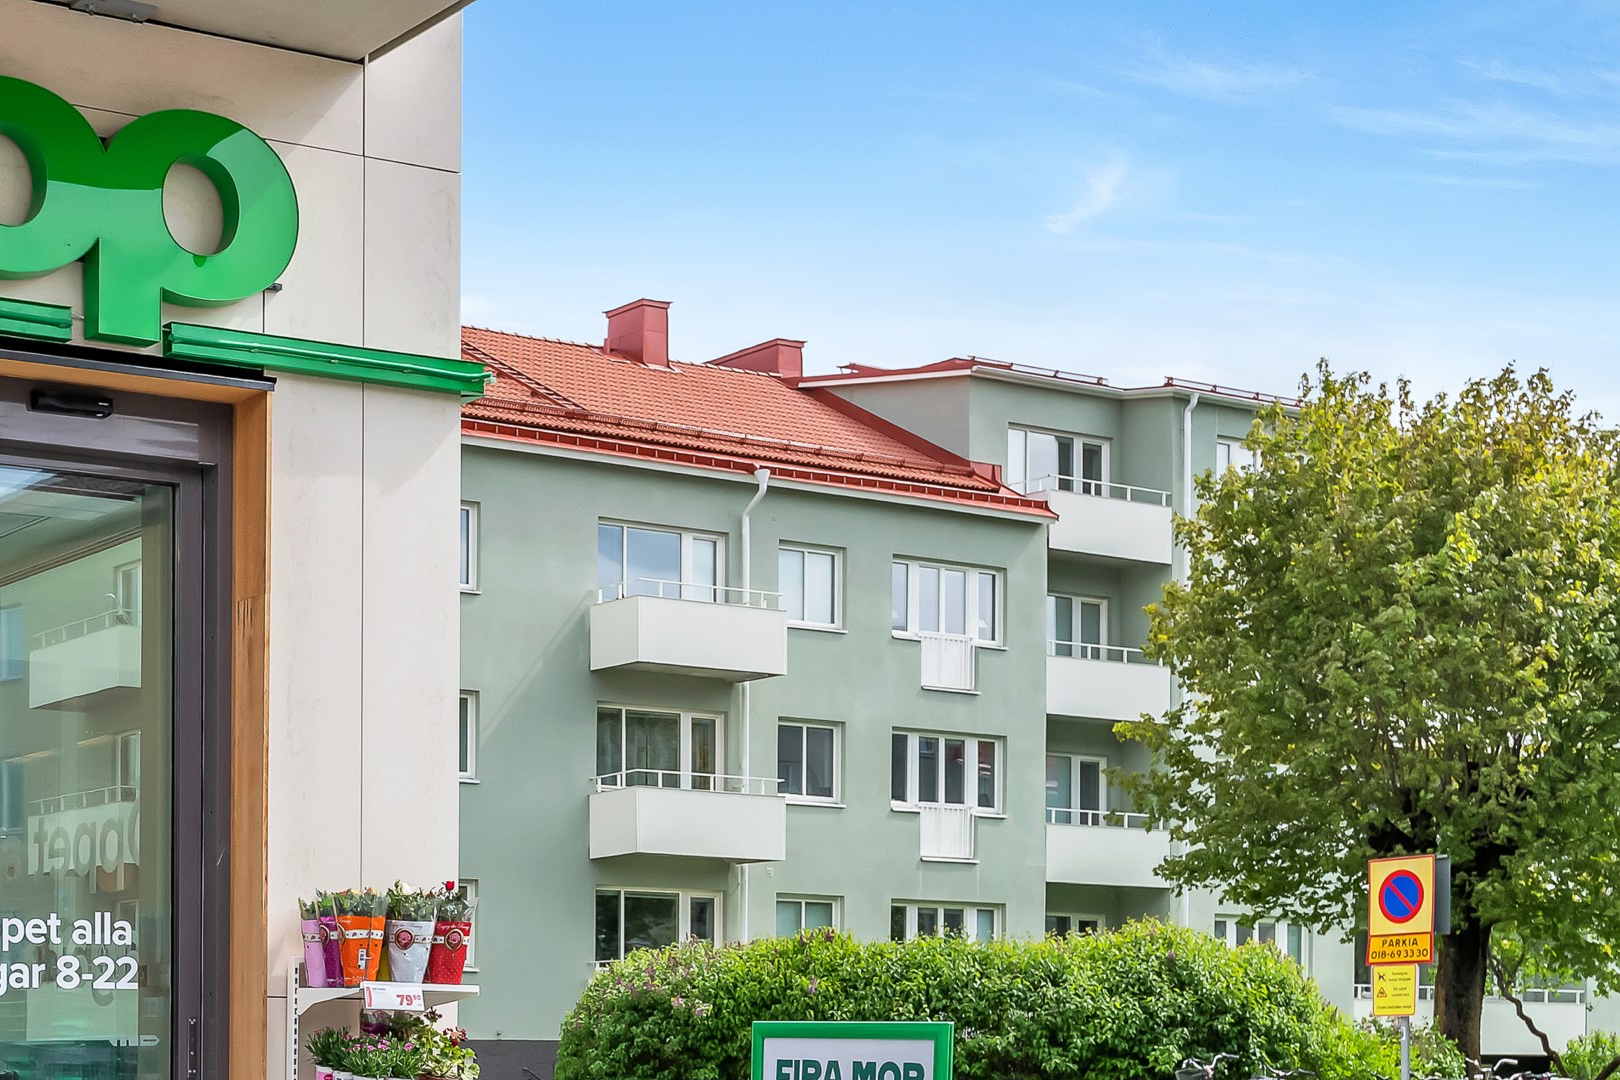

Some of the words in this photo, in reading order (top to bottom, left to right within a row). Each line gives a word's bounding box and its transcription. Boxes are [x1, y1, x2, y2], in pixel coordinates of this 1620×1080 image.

[71, 911, 132, 946] alla
[1381, 938, 1419, 948] PARKIA
[55, 955, 139, 990] 8-22
